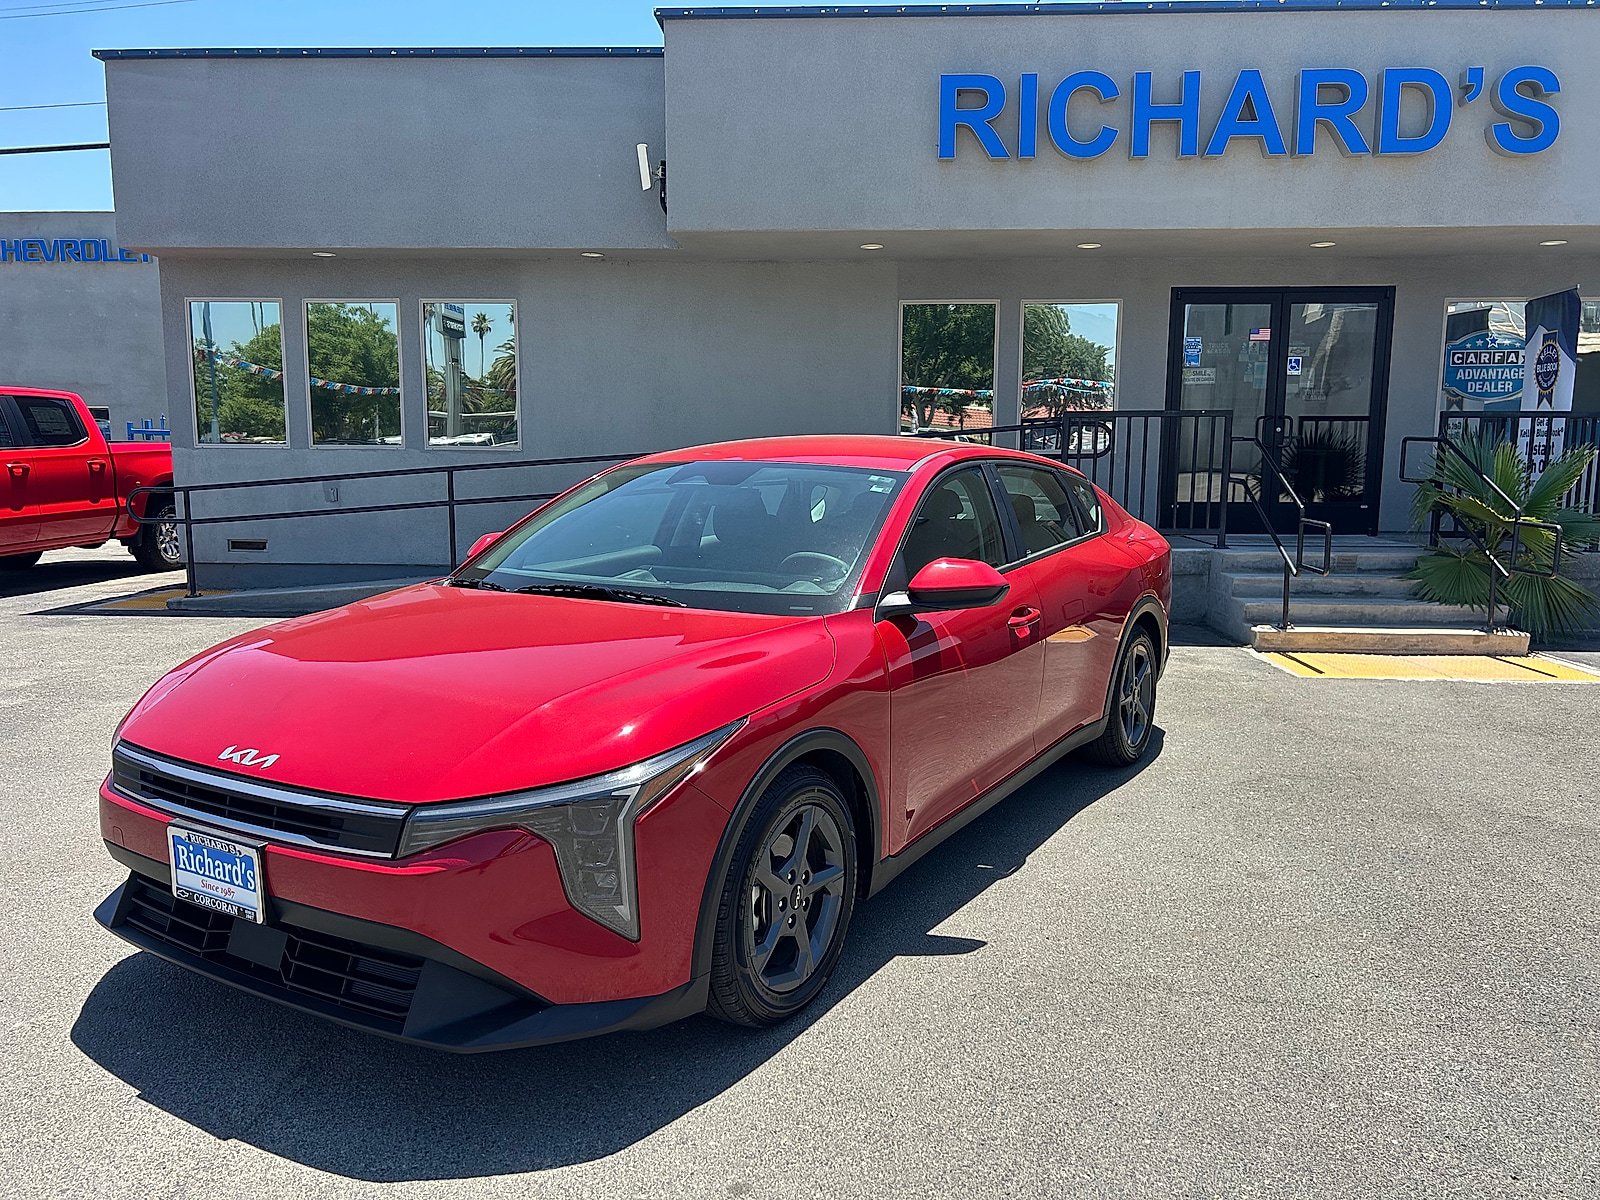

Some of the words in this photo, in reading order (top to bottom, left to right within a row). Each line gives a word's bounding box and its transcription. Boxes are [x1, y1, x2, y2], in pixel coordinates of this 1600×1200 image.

[937, 65, 1562, 160] RICHARD'S
[1456, 368, 1525, 380] ADVANTAGE
[1536, 363, 1547, 373] BLUE
[1467, 381, 1513, 393] DEALER
[177, 844, 255, 890] Richard's
[201, 879, 220, 892] Since
[220, 886, 236, 899] 1987
[193, 893, 239, 916] CORCORAN
